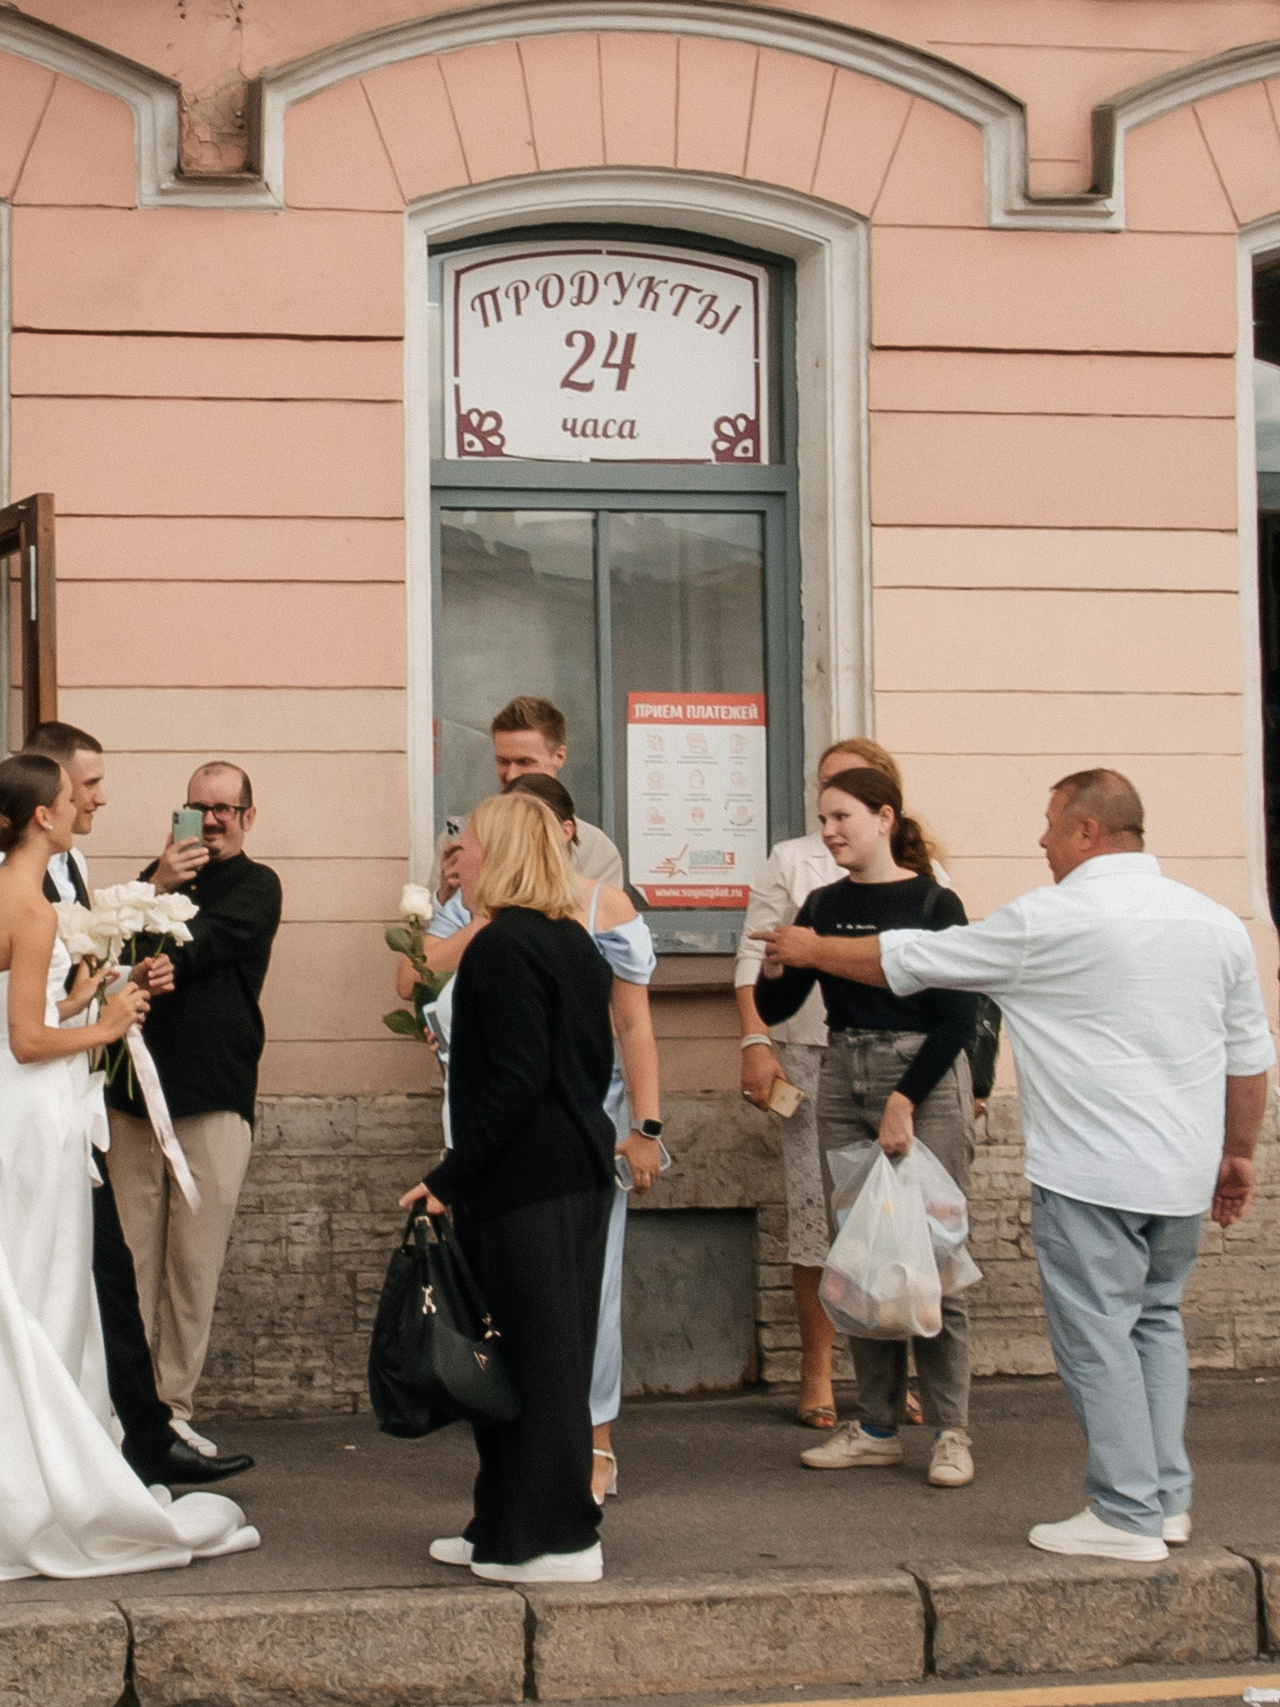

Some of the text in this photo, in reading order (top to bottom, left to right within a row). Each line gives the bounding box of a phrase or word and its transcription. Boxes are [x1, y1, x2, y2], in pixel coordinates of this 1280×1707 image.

[470, 269, 742, 336] ПРОДУКТЫ
[560, 329, 638, 393] 24
[561, 416, 638, 440] часа
[633, 703, 758, 720] ПРИЕМ ПЛАТЕЖЕЙ
